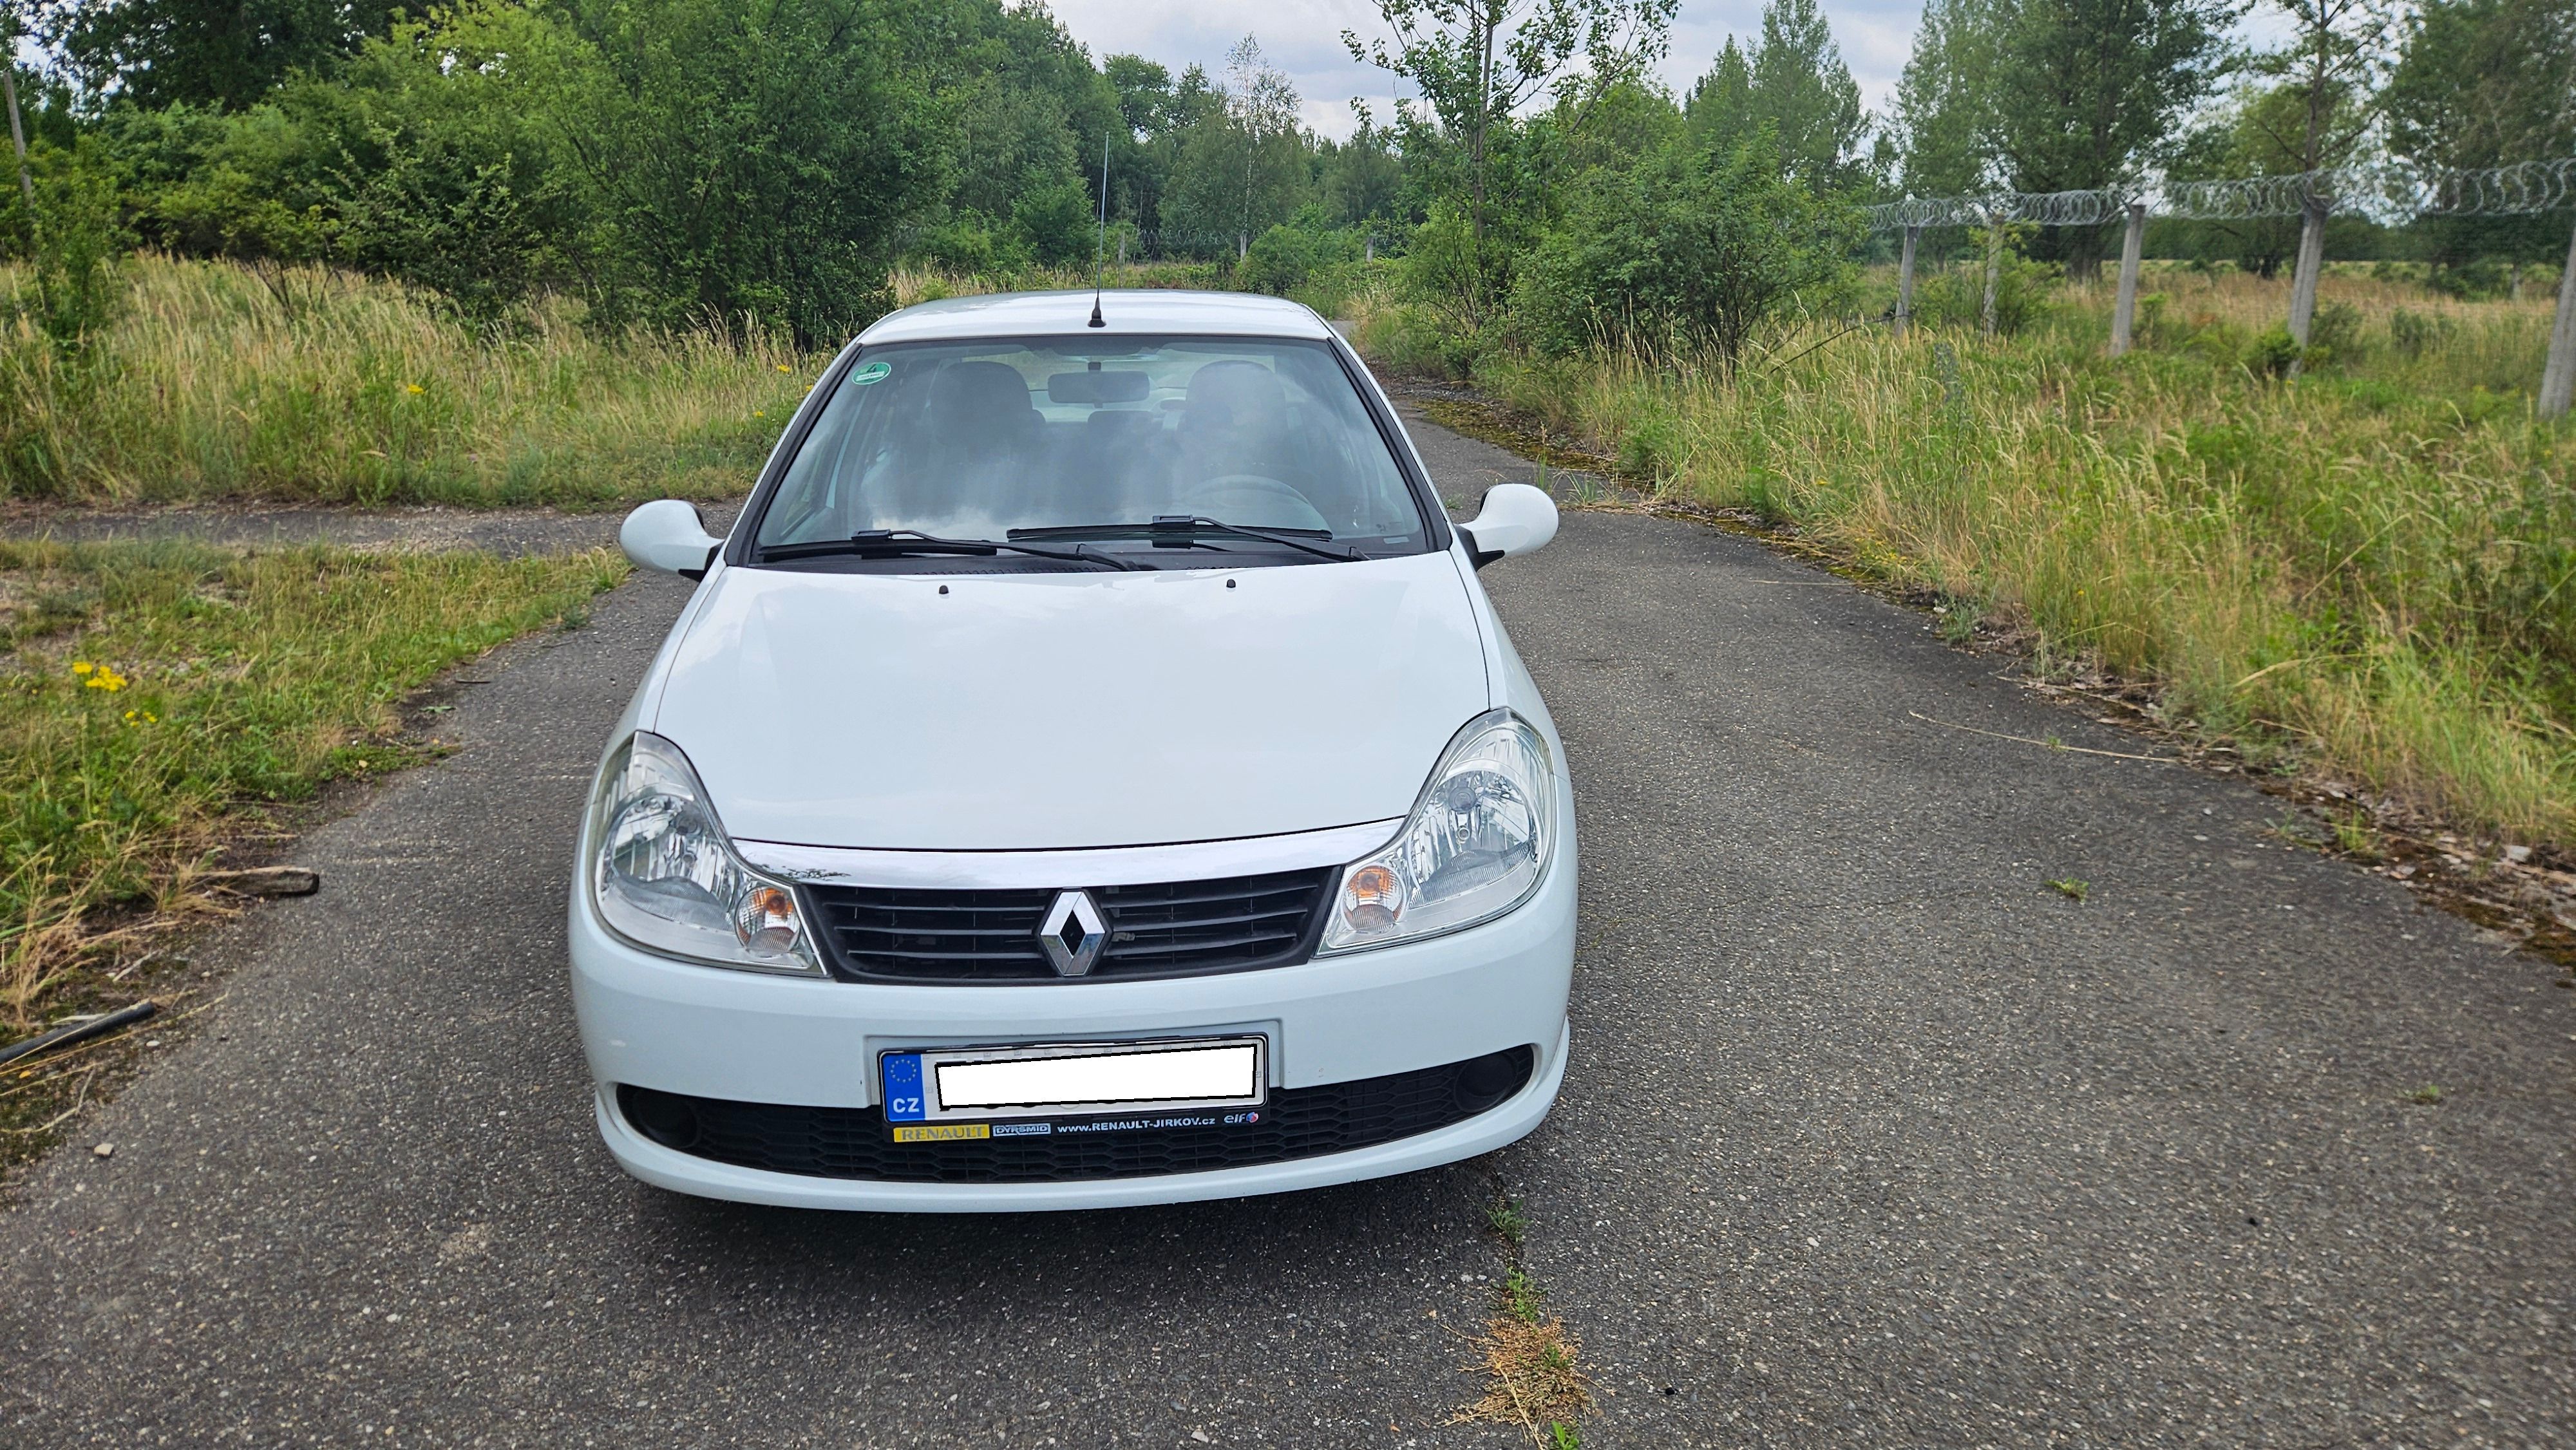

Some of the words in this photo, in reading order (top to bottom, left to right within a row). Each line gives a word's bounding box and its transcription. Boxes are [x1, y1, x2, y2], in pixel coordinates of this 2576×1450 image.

[866, 363, 876, 373] 4
[893, 1097, 920, 1113] CZ
[902, 1126, 985, 1140] RENAULT
[996, 1125, 1048, 1135] DYRSMID
[1057, 1117, 1216, 1133] www.RENAULT-JIRKOV.cz
[1224, 1113, 1246, 1124] elf
